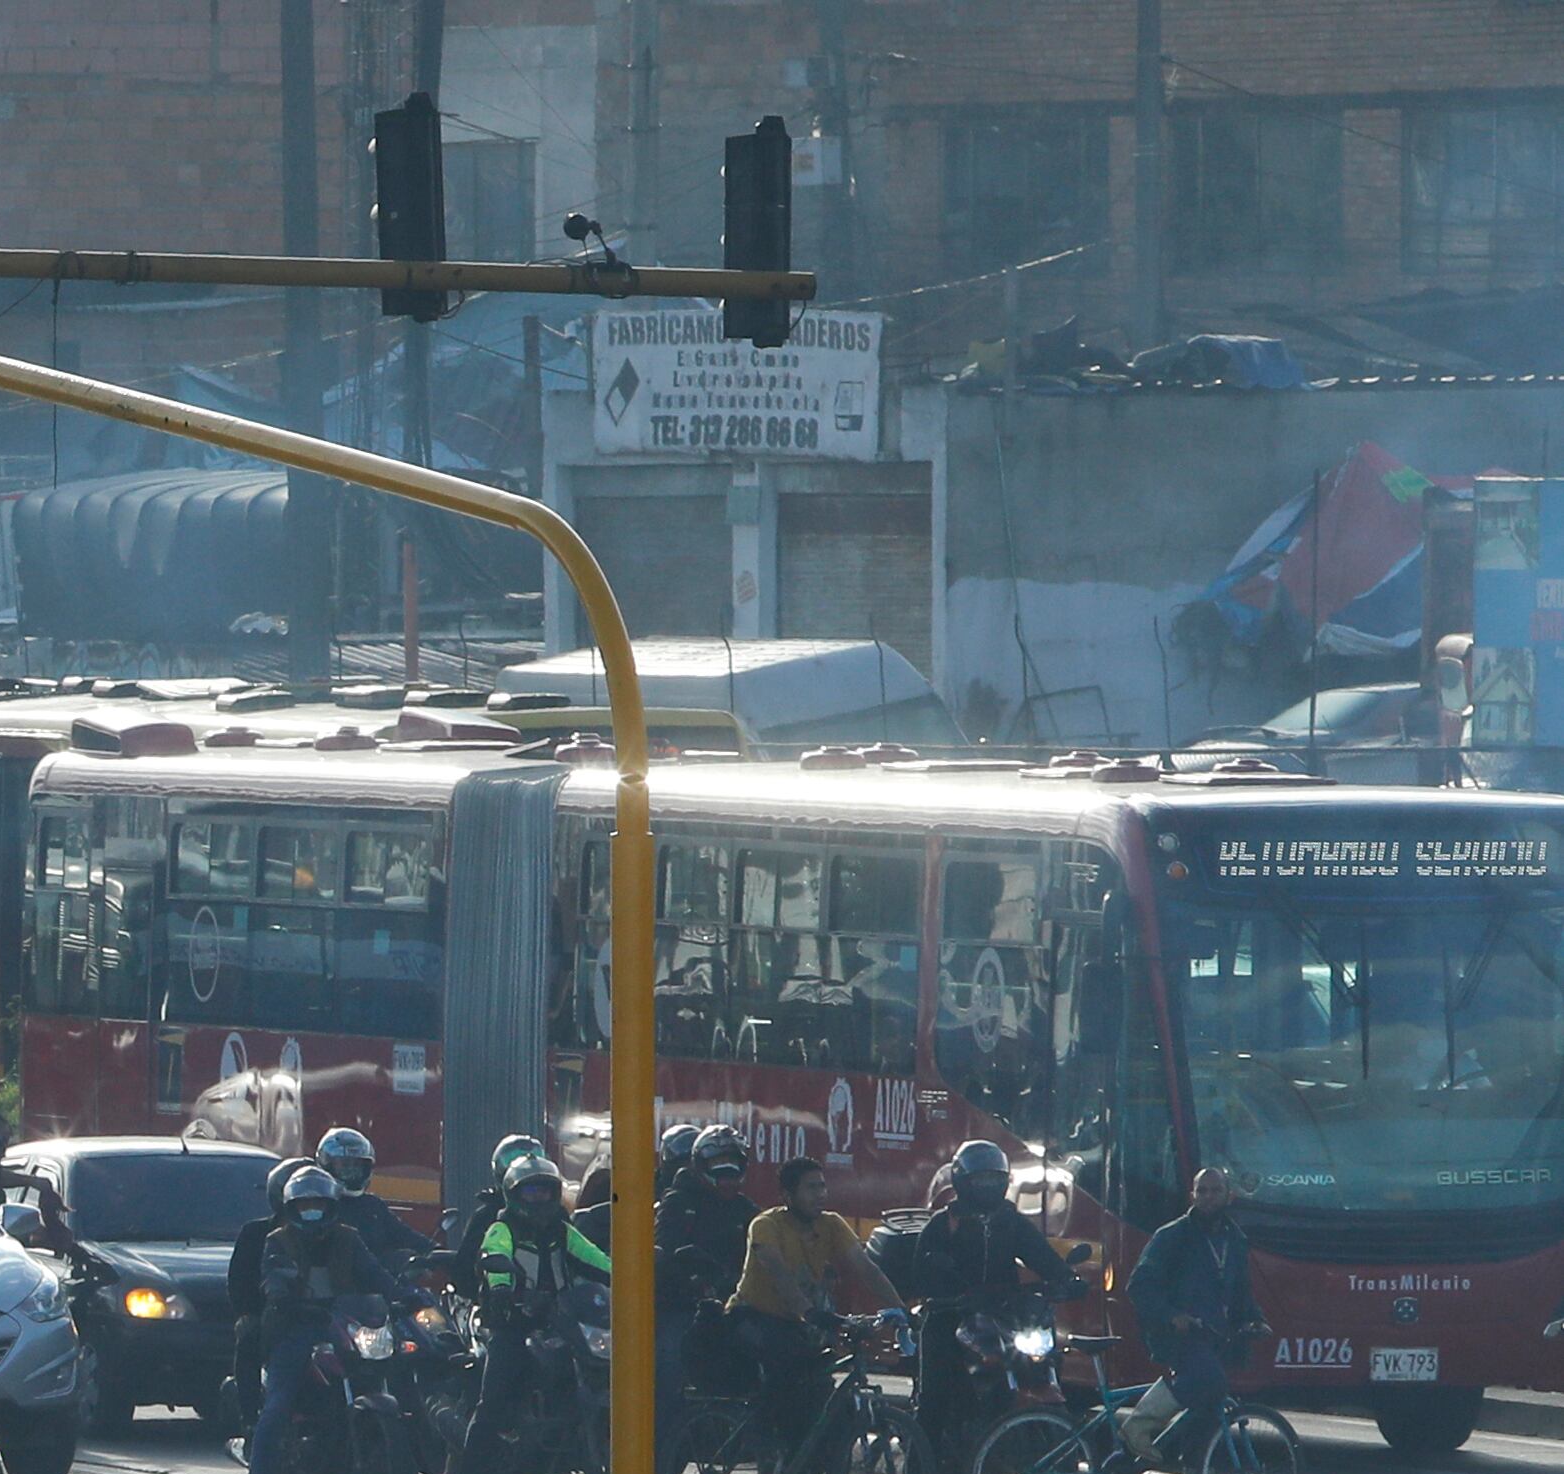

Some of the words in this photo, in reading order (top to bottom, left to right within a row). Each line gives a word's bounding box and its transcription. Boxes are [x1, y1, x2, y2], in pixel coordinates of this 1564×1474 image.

[875, 1078, 915, 1132] A1026
[1268, 1174, 1335, 1186] SCANIA
[1437, 1168, 1551, 1185] BUSSCAR
[1348, 1274, 1472, 1291] TransMilenio
[1274, 1338, 1353, 1364] A1026
